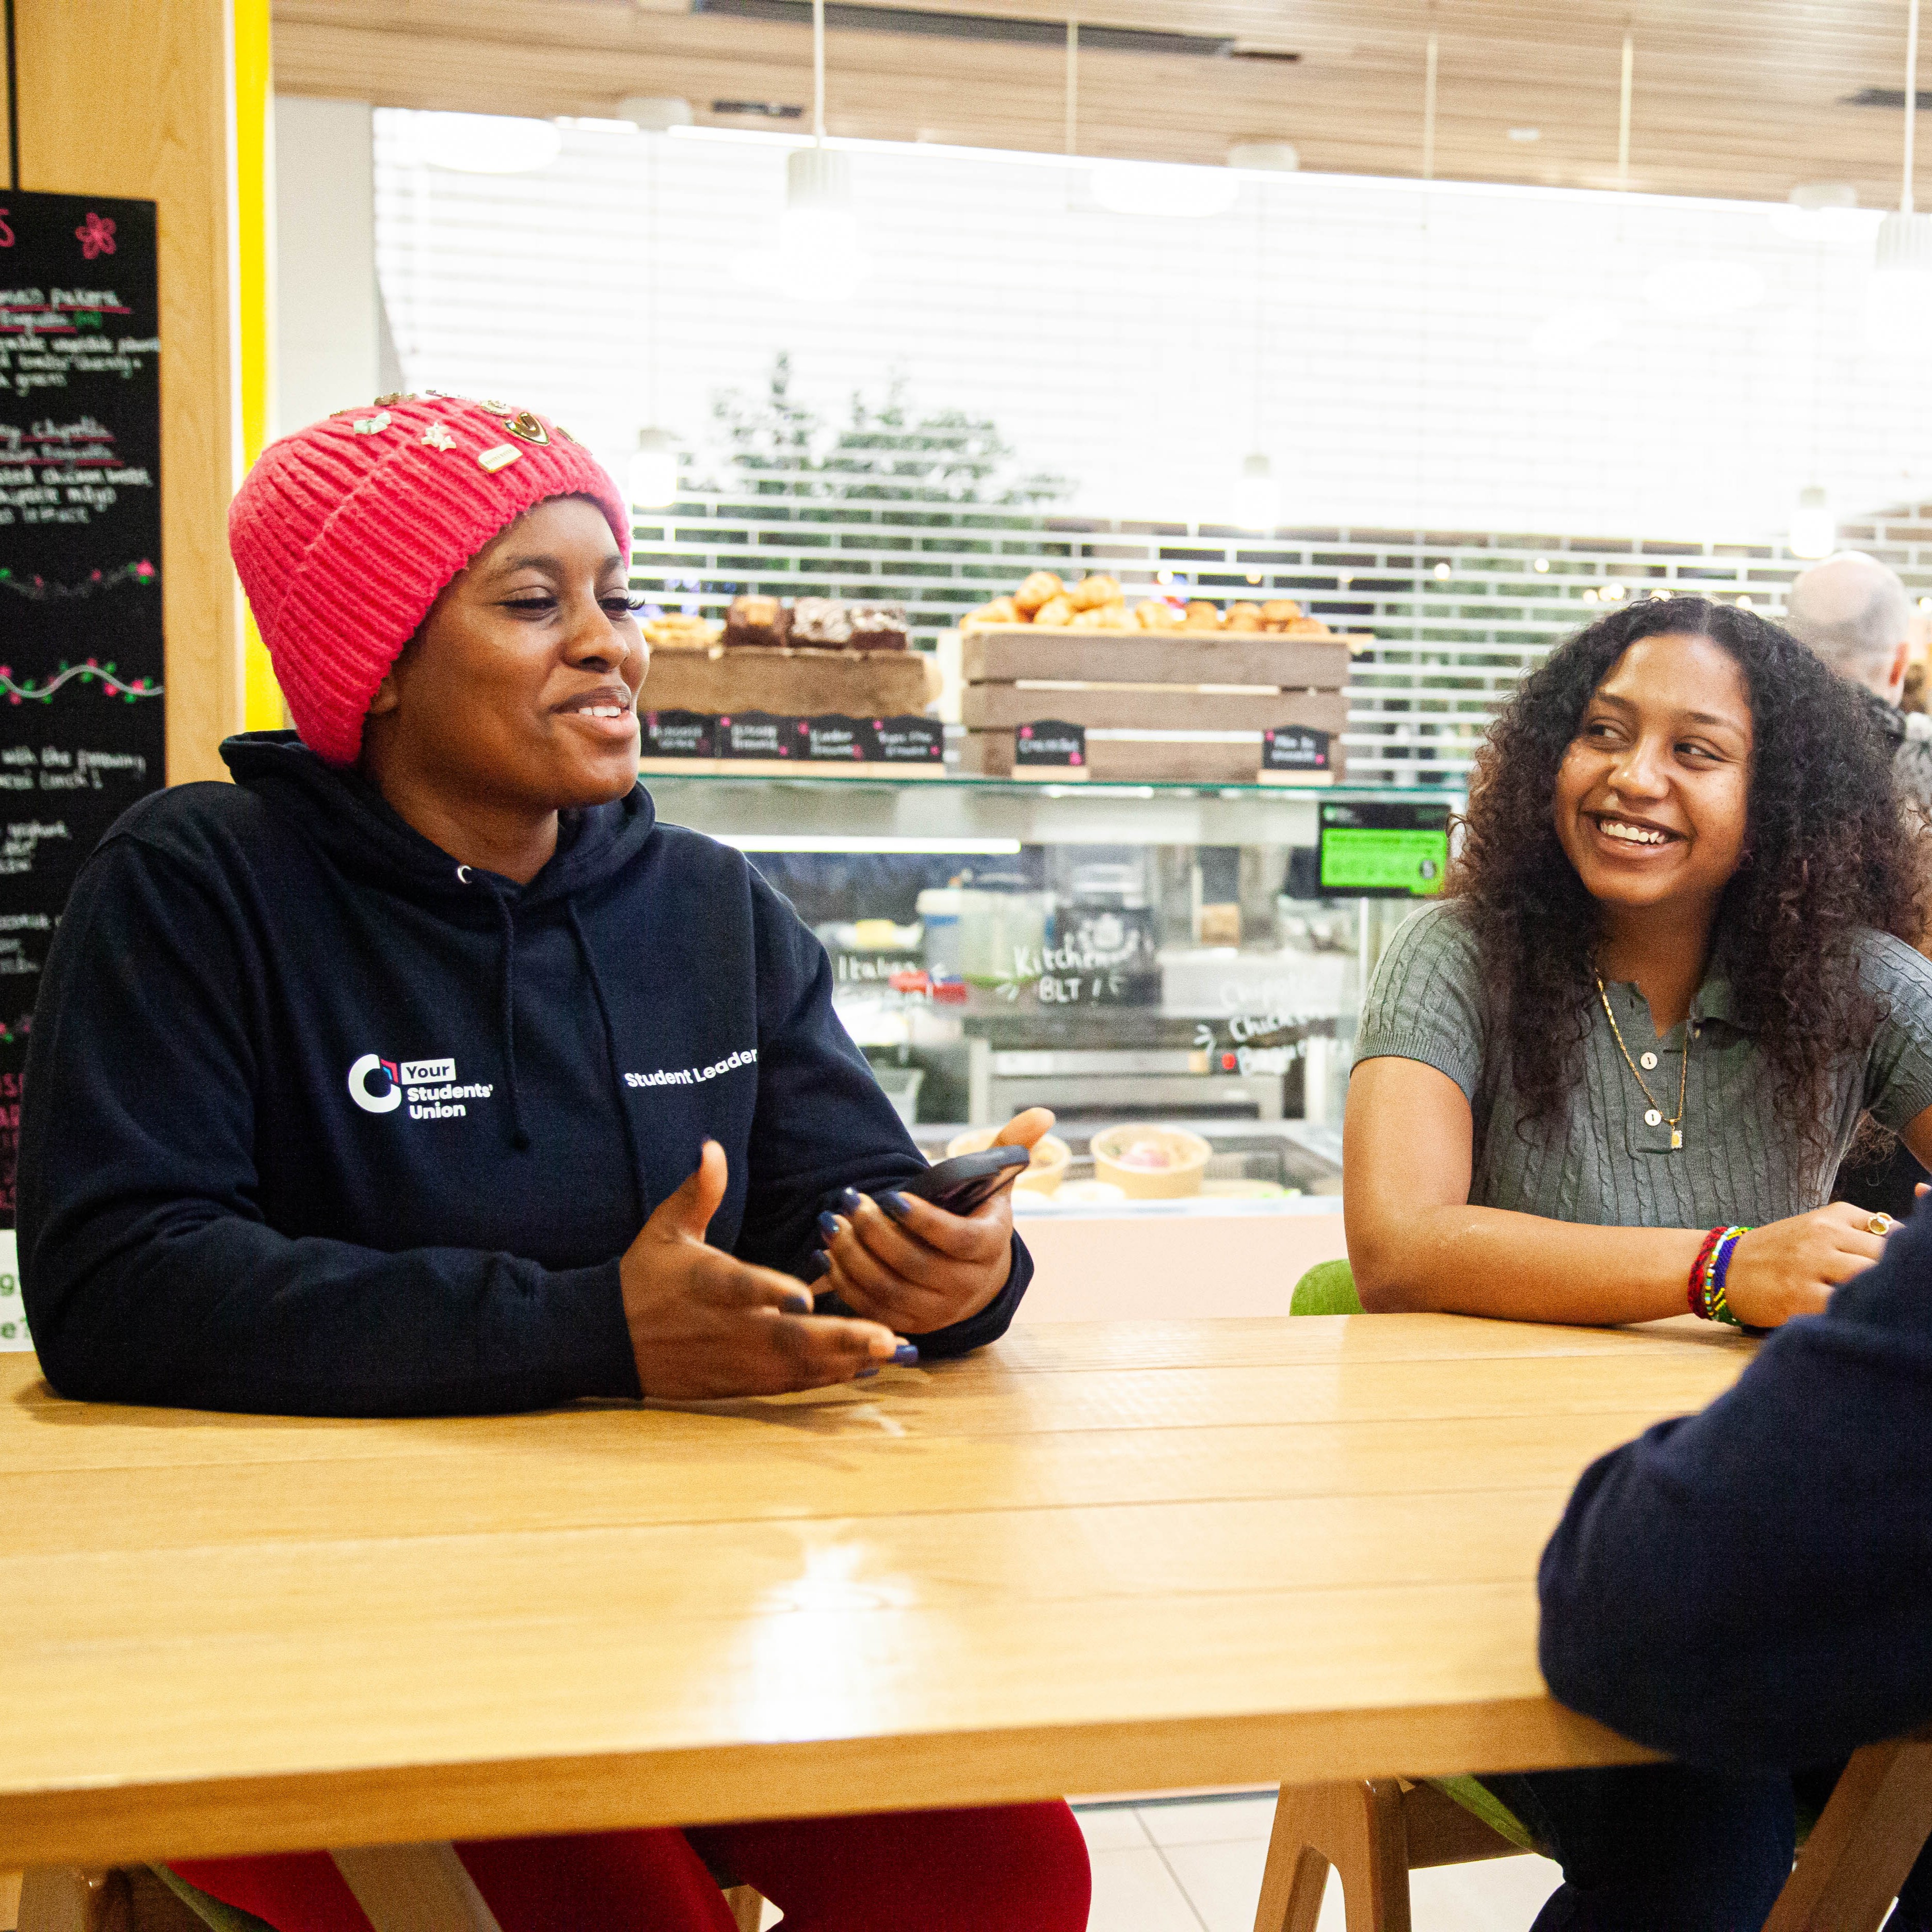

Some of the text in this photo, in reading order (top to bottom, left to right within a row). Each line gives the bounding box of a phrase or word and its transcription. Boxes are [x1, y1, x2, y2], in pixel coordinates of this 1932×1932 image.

[1039, 975, 1082, 1003] BLT
[406, 1066, 450, 1079] Your
[624, 1049, 758, 1087] Student Leader
[407, 1083, 493, 1102] Students'
[410, 1102, 466, 1119] Union
